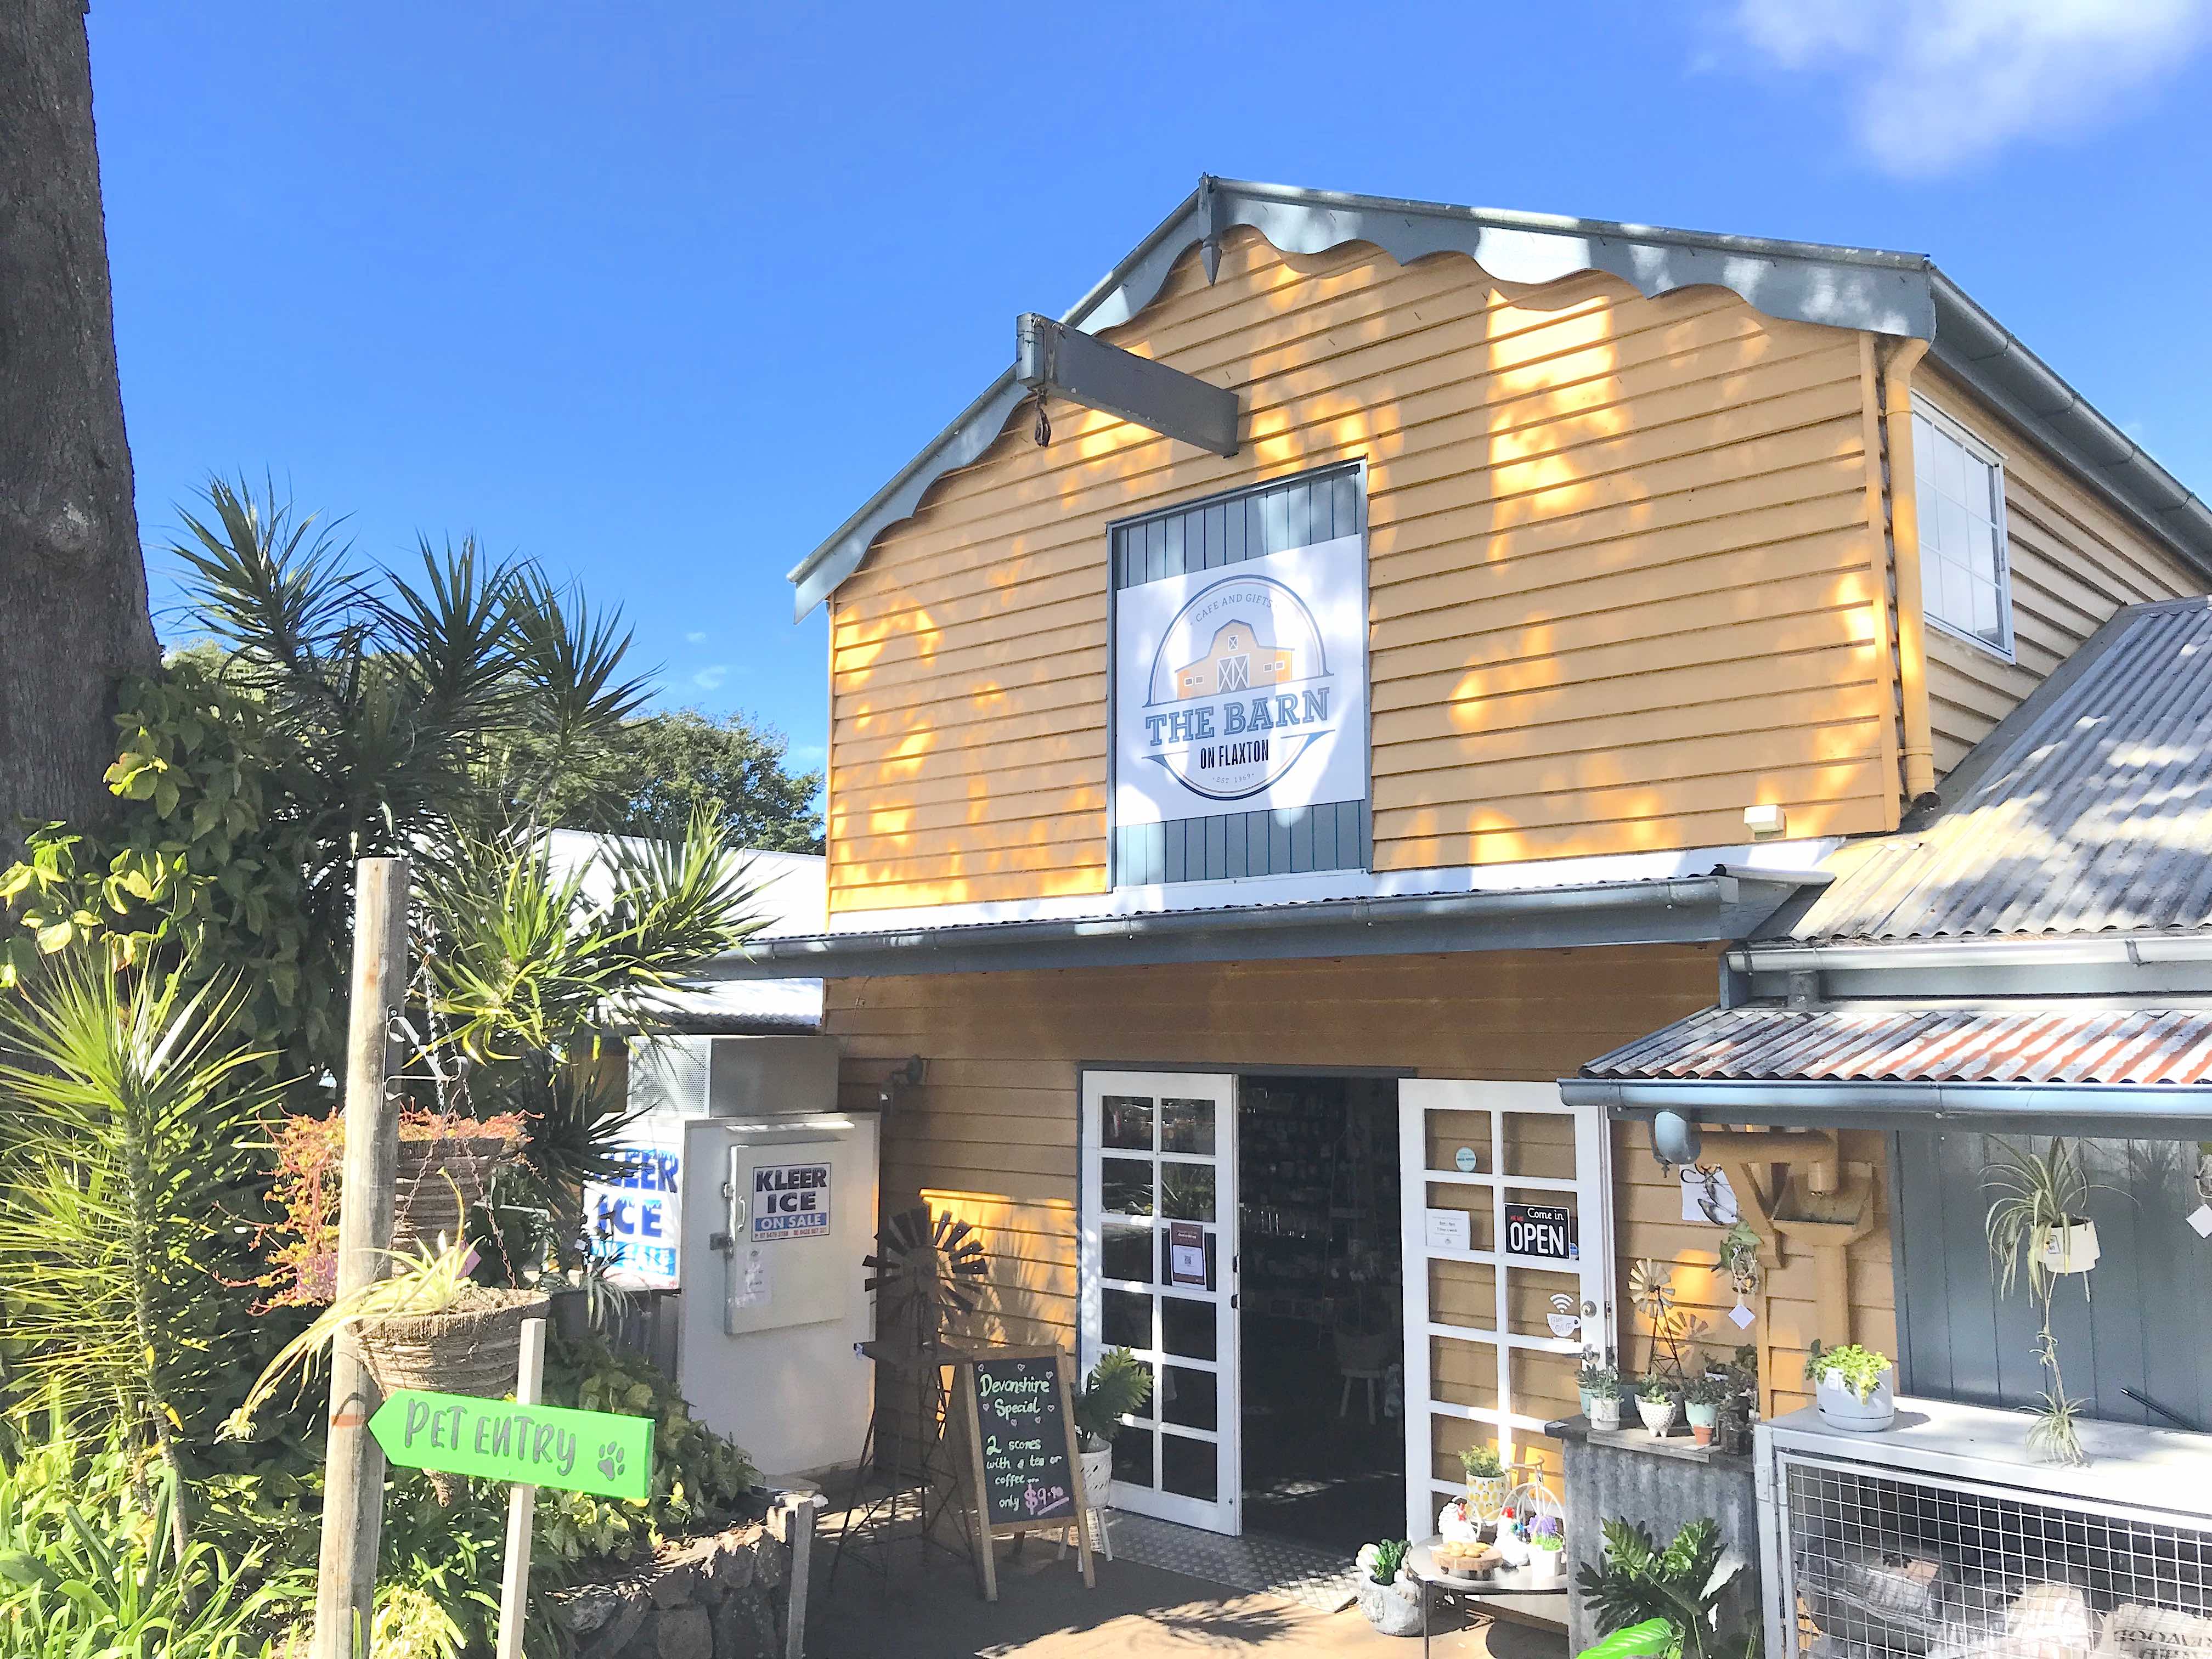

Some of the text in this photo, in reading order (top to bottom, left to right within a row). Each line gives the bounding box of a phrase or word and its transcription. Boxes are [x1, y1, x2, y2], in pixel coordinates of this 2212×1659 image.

[1195, 593, 1273, 622] CAFE AND GIFTS
[1146, 687, 1330, 746] THE BARN
[1200, 739, 1268, 769] ON FLAXTON
[756, 1167, 827, 1192] KLEER
[768, 1191, 816, 1214] ICE
[1527, 1207, 1553, 1220] Come
[1554, 1210, 1565, 1221] in
[760, 1214, 821, 1230] ON SALE
[1510, 1222, 1564, 1256] OPEN
[980, 1373, 1050, 1397] Devonshire
[994, 1397, 1041, 1420] Special
[404, 1398, 576, 1476] PET ENTRY
[986, 1435, 1041, 1455] 2 scones
[986, 1454, 1063, 1469] with a tea or
[998, 1495, 1020, 1511] only
